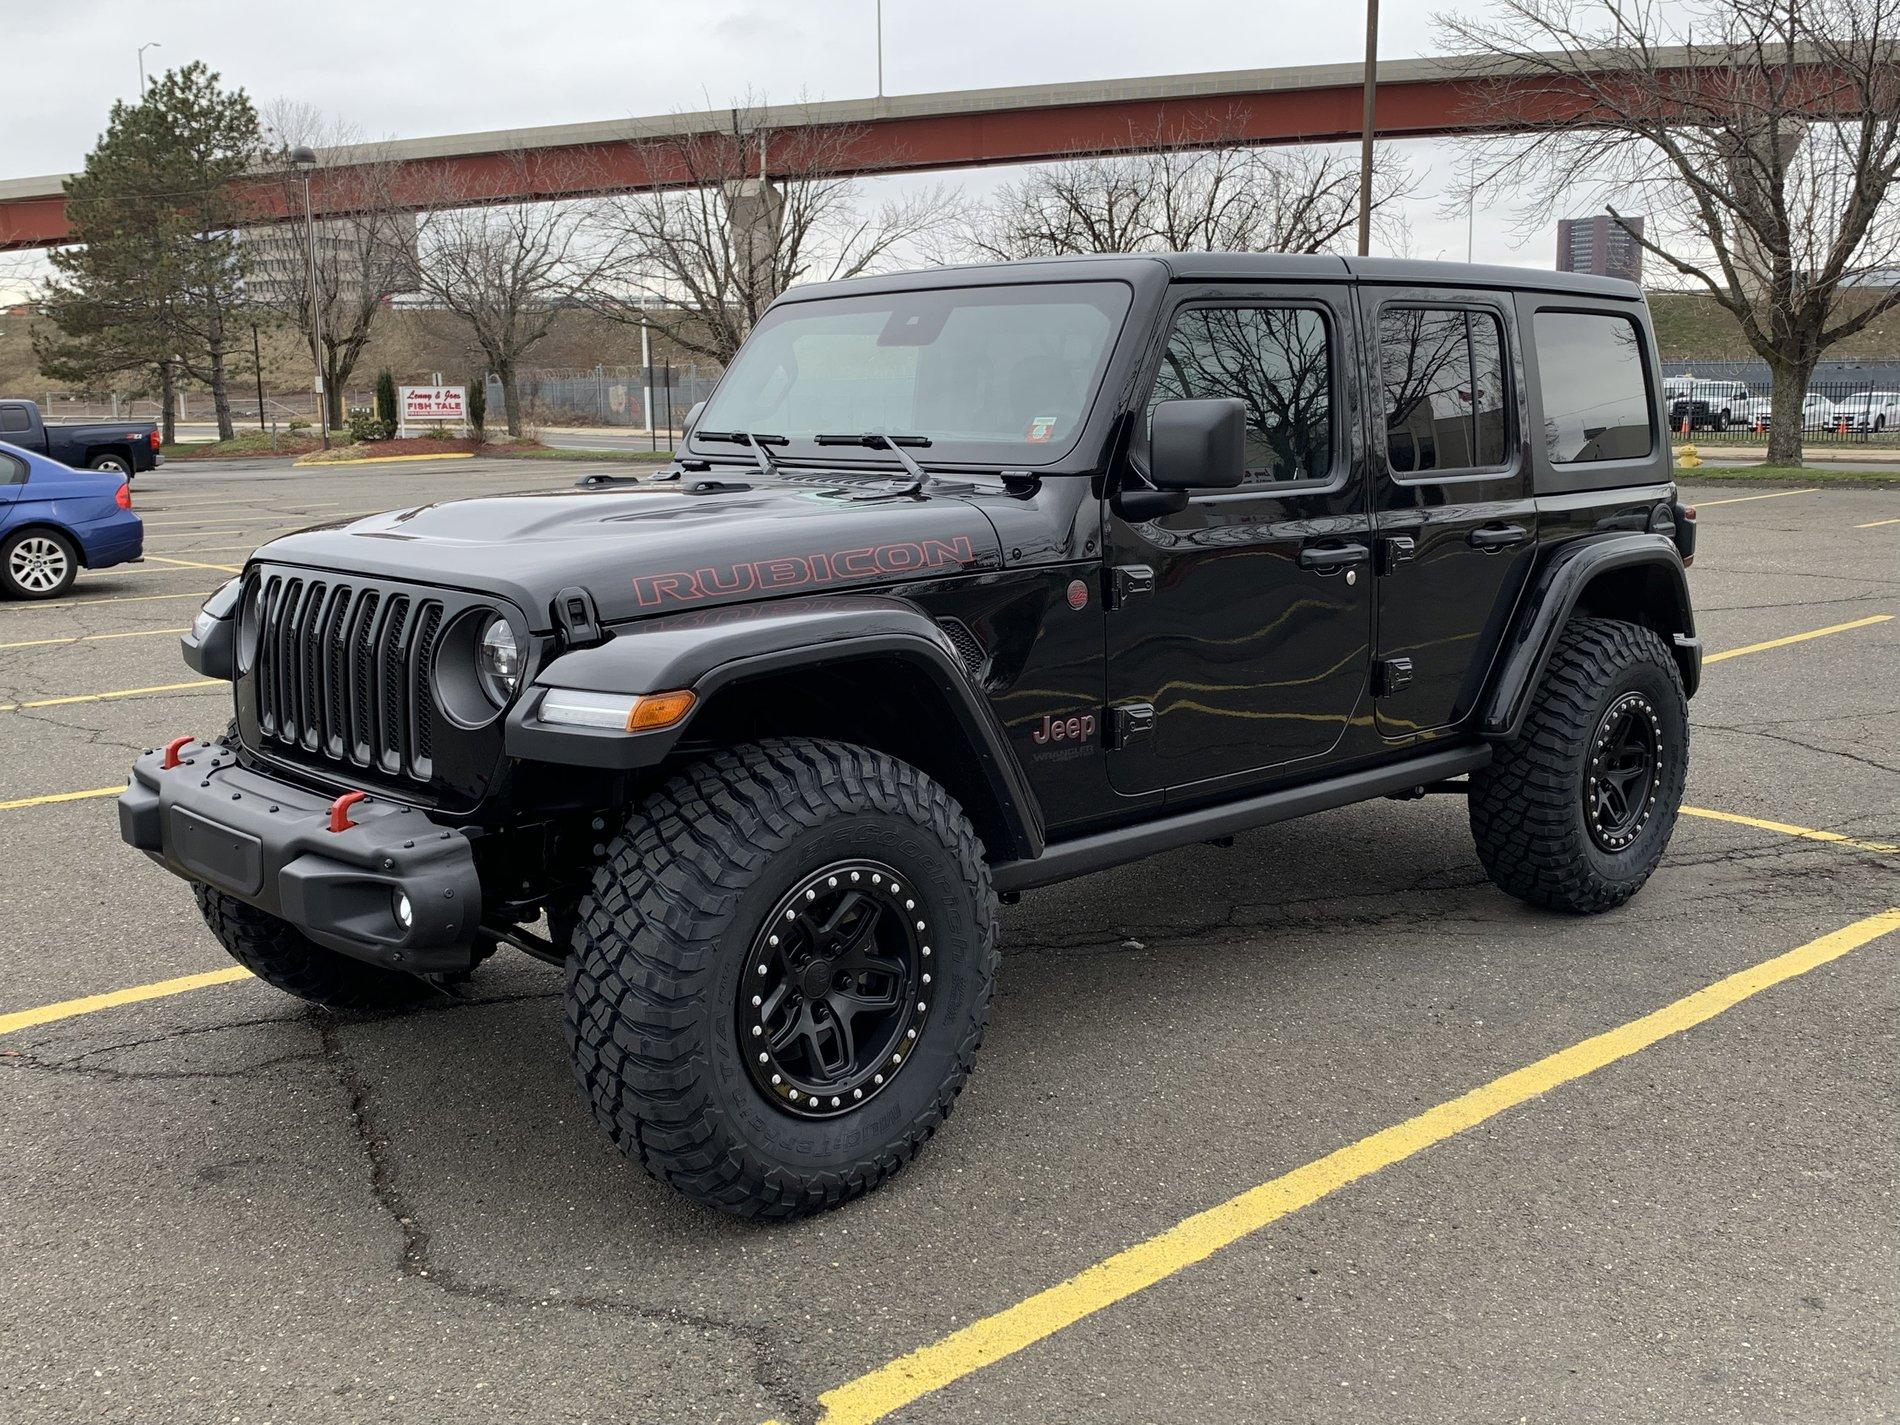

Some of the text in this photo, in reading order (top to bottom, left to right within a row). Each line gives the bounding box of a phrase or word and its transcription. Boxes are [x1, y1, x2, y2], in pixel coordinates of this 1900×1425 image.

[407, 402, 461, 410] FISH TALE
[632, 536, 974, 606] RUBICON
[1032, 714, 1096, 745] Jeep
